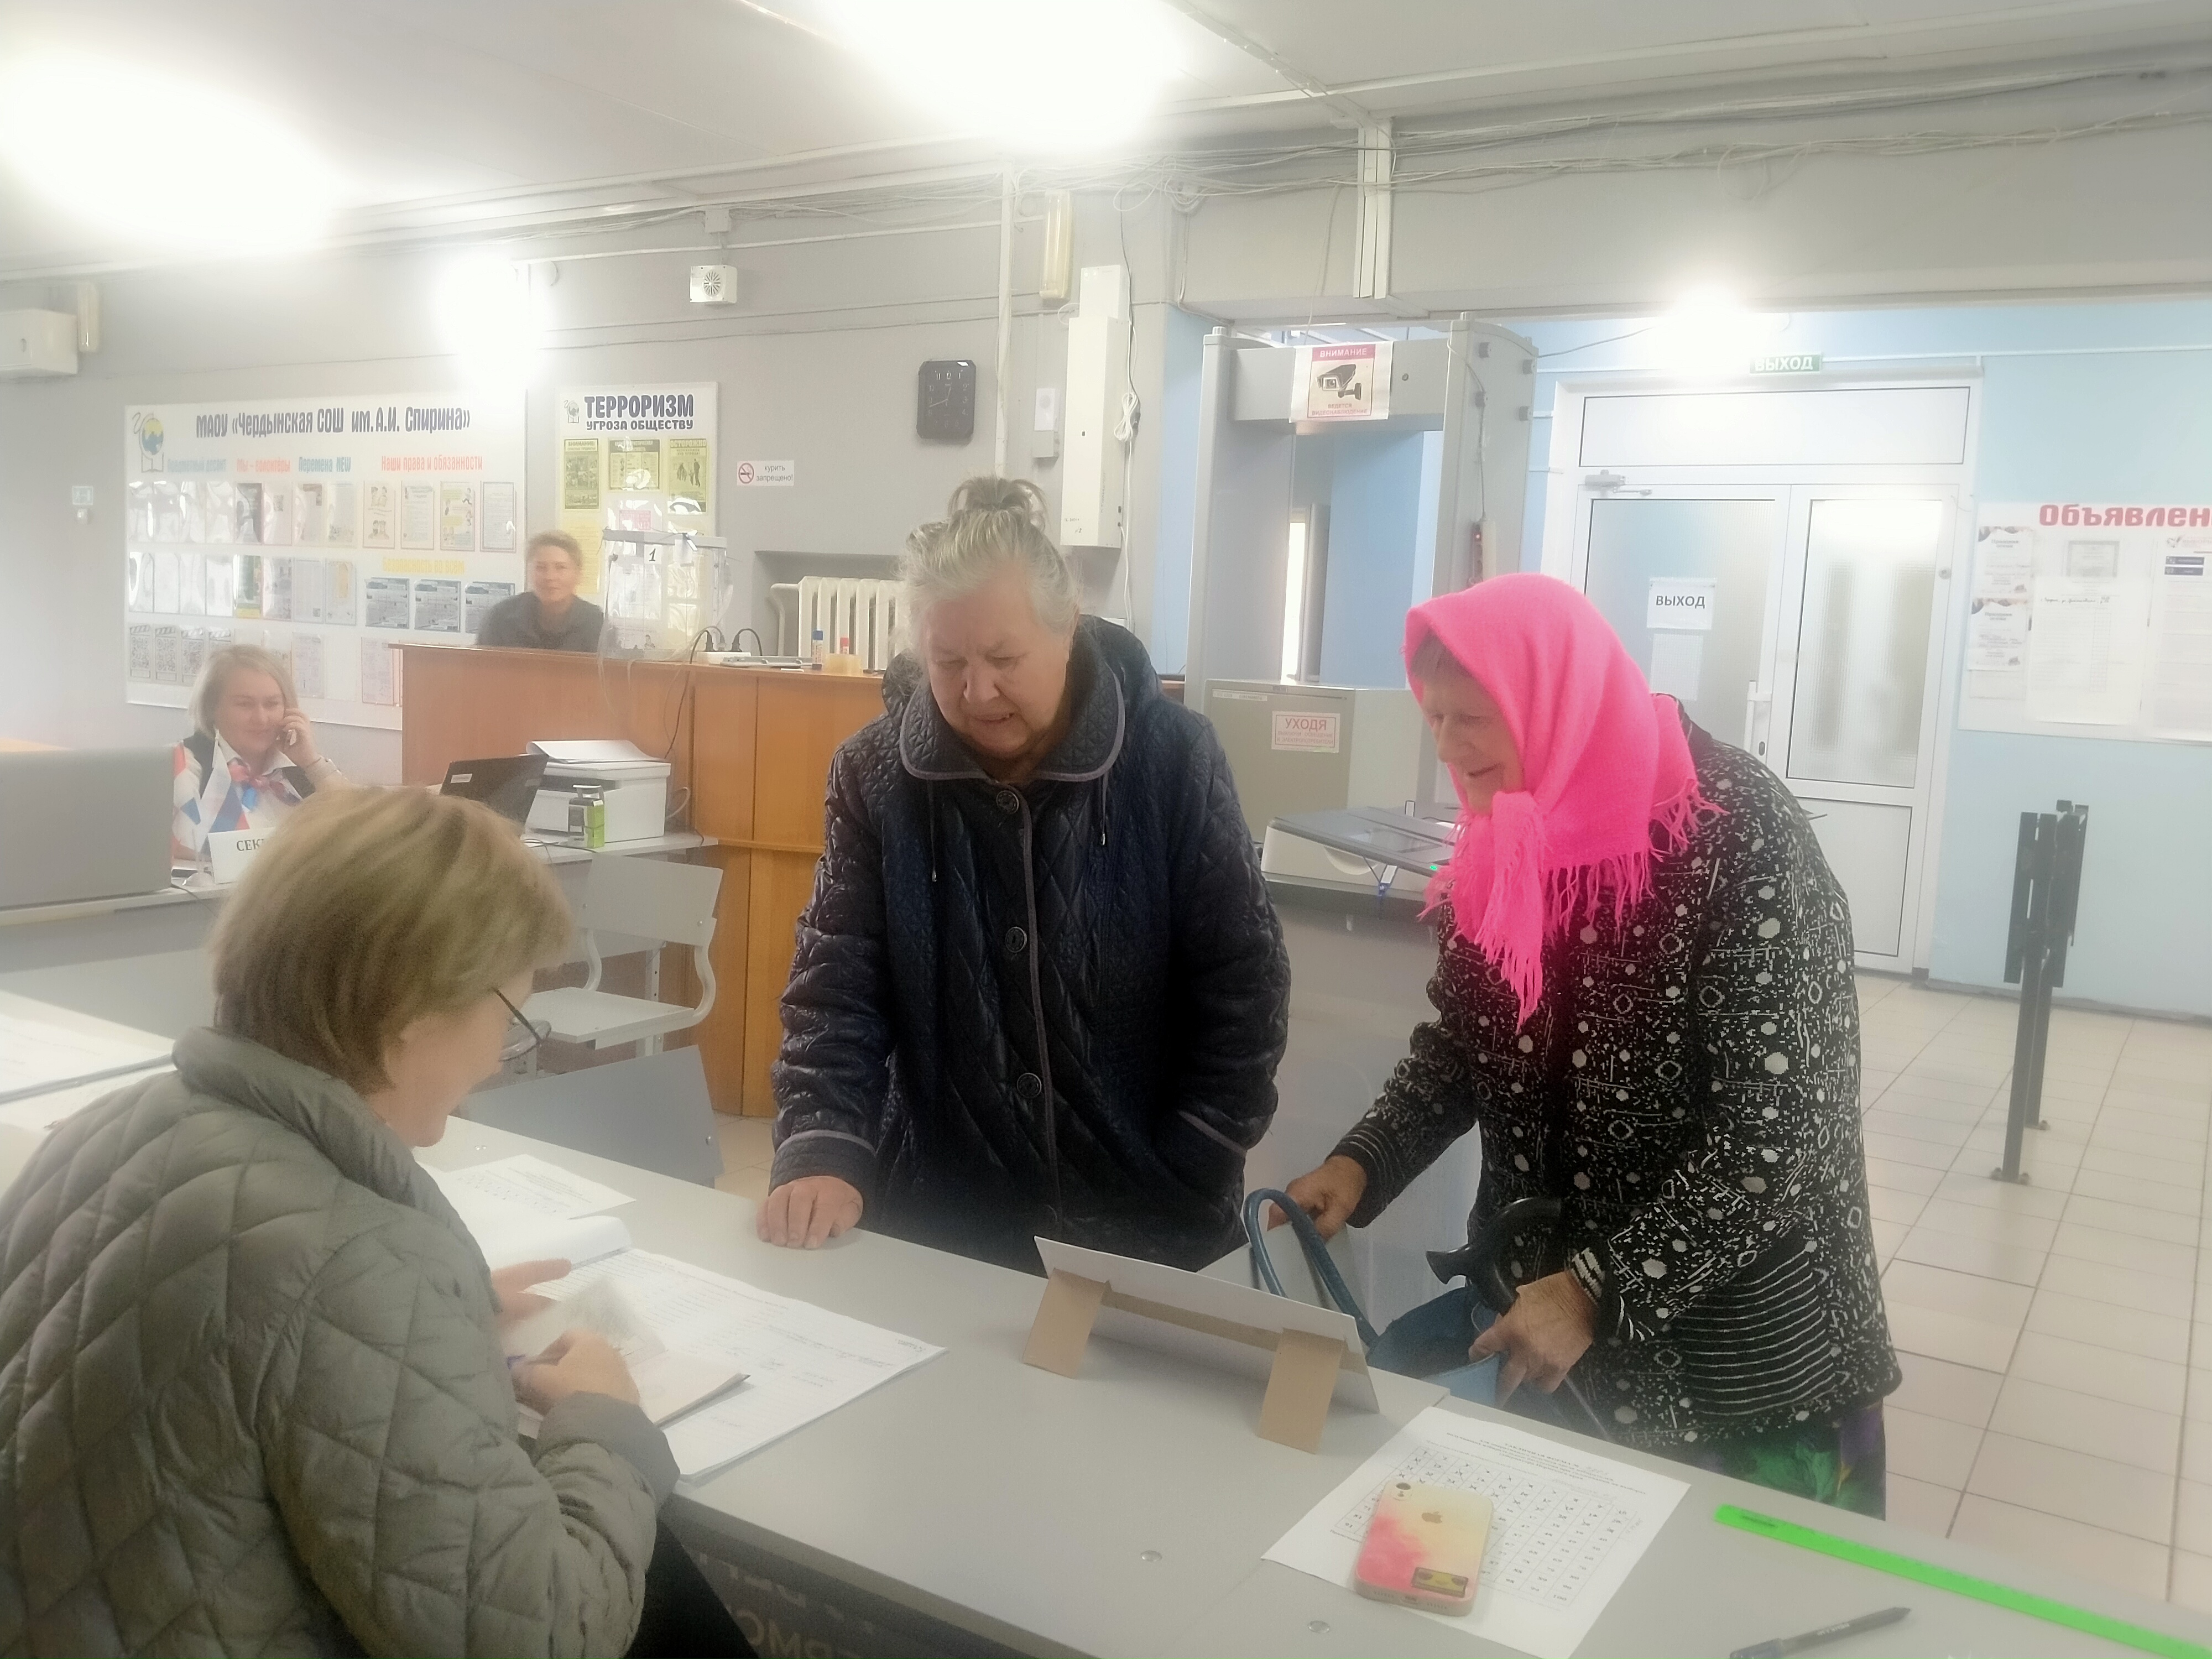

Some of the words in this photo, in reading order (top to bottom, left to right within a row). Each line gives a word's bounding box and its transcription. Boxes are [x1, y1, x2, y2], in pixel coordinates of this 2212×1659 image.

[1320, 348, 1367, 357] ВНИМАНИЕ
[1755, 356, 1813, 371] ВЫХОД
[584, 394, 694, 418] ТЕРРОРИЗМ
[196, 414, 228, 438] МАОУ
[232, 412, 313, 438] «Чердынская
[317, 408, 344, 433] СОШ
[405, 406, 470, 434] Спирина»
[586, 420, 628, 430] УГРОЗА
[630, 420, 693, 431] ОБЩЕСТВУ
[299, 456, 332, 473] Перемена
[336, 457, 351, 472] NEW
[382, 456, 401, 471] Наши
[404, 457, 425, 472] права
[427, 457, 431, 471] и
[434, 455, 483, 471] обязанности
[756, 474, 793, 483] запрещено!
[2039, 504, 2211, 527] Объявлен
[649, 547, 656, 562] 1
[1656, 595, 1705, 609] ВЫХОД
[1285, 718, 1327, 732] УХОДЯ
[236, 838, 264, 851] СЕК
